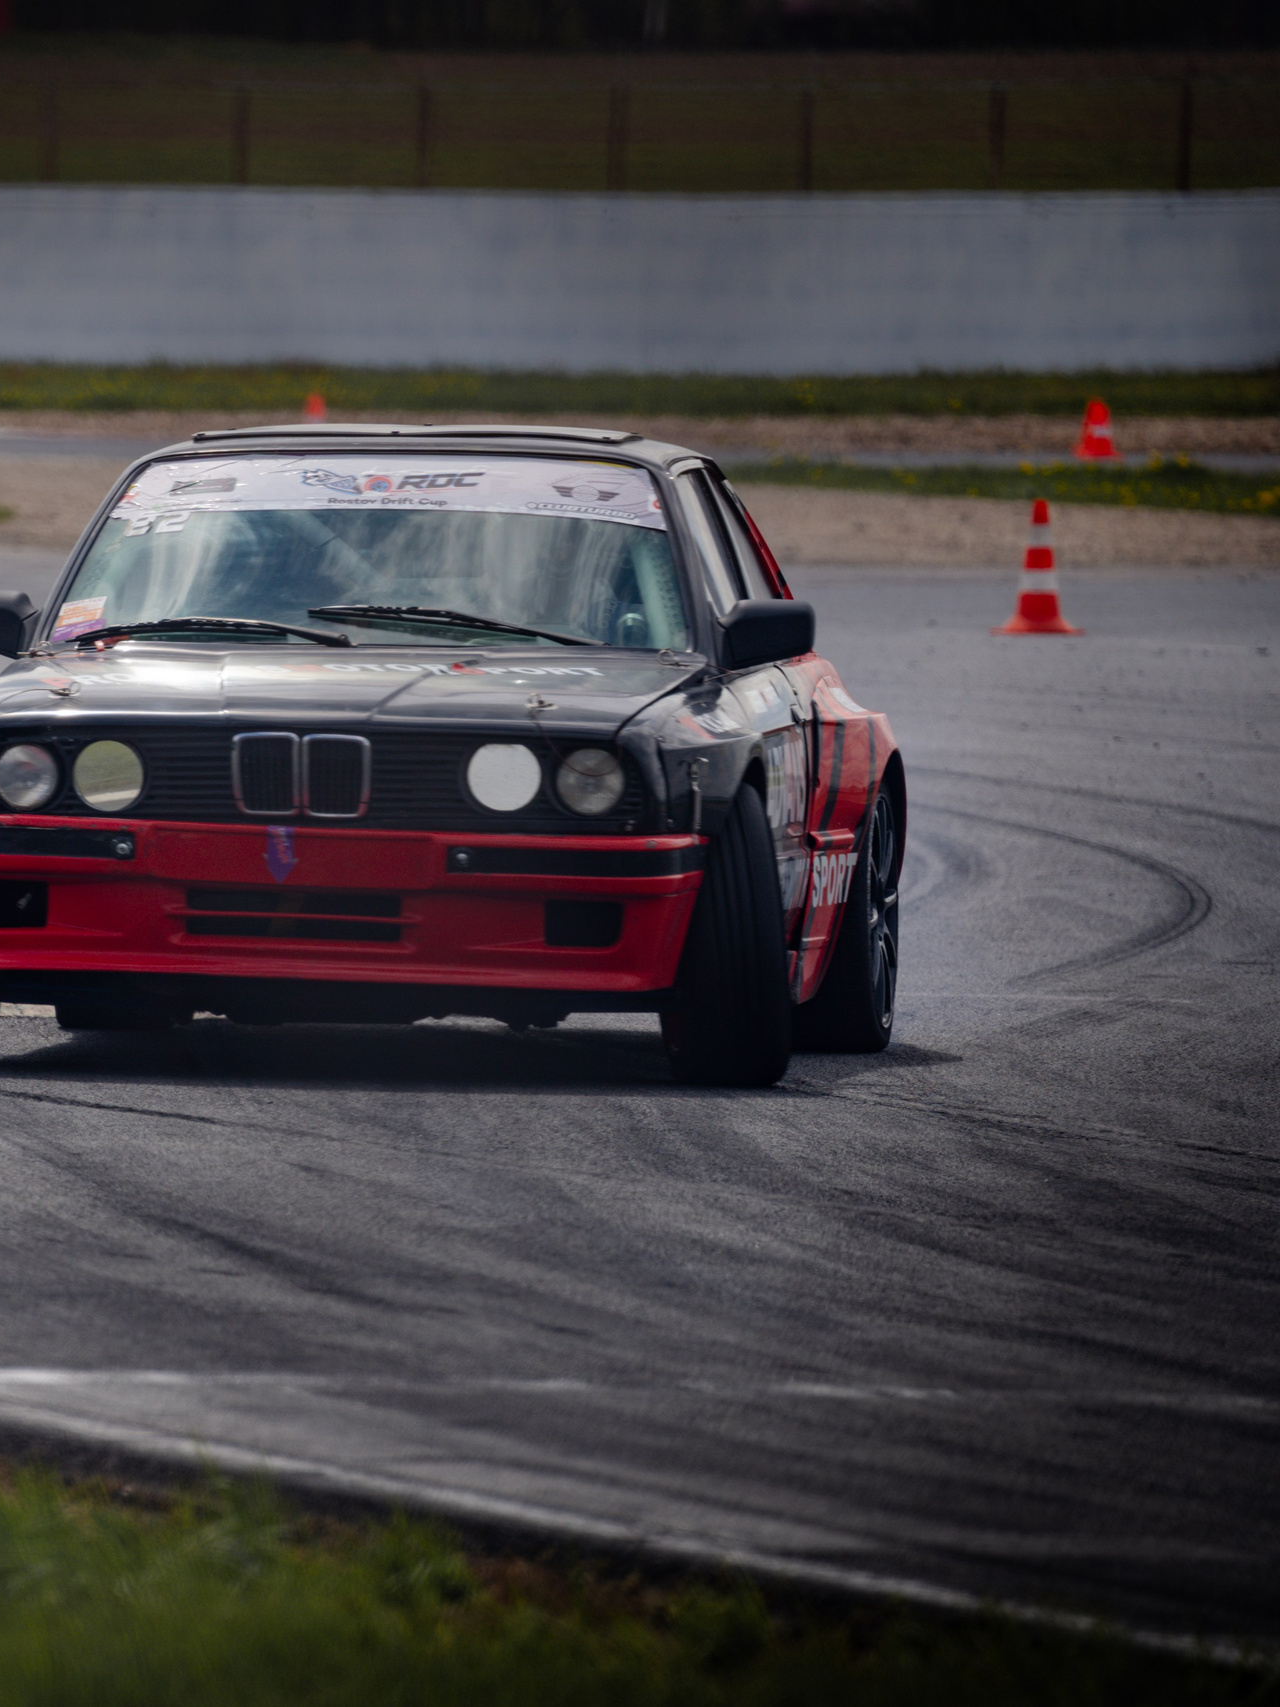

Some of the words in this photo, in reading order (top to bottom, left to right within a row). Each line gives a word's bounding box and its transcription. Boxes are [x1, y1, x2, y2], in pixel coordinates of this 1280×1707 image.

[397, 472, 485, 489] RDC
[327, 497, 376, 505] Rostov
[381, 497, 414, 505] Drift
[418, 498, 448, 507] Cup
[124, 511, 190, 537] 82
[812, 852, 858, 908] SPORT
